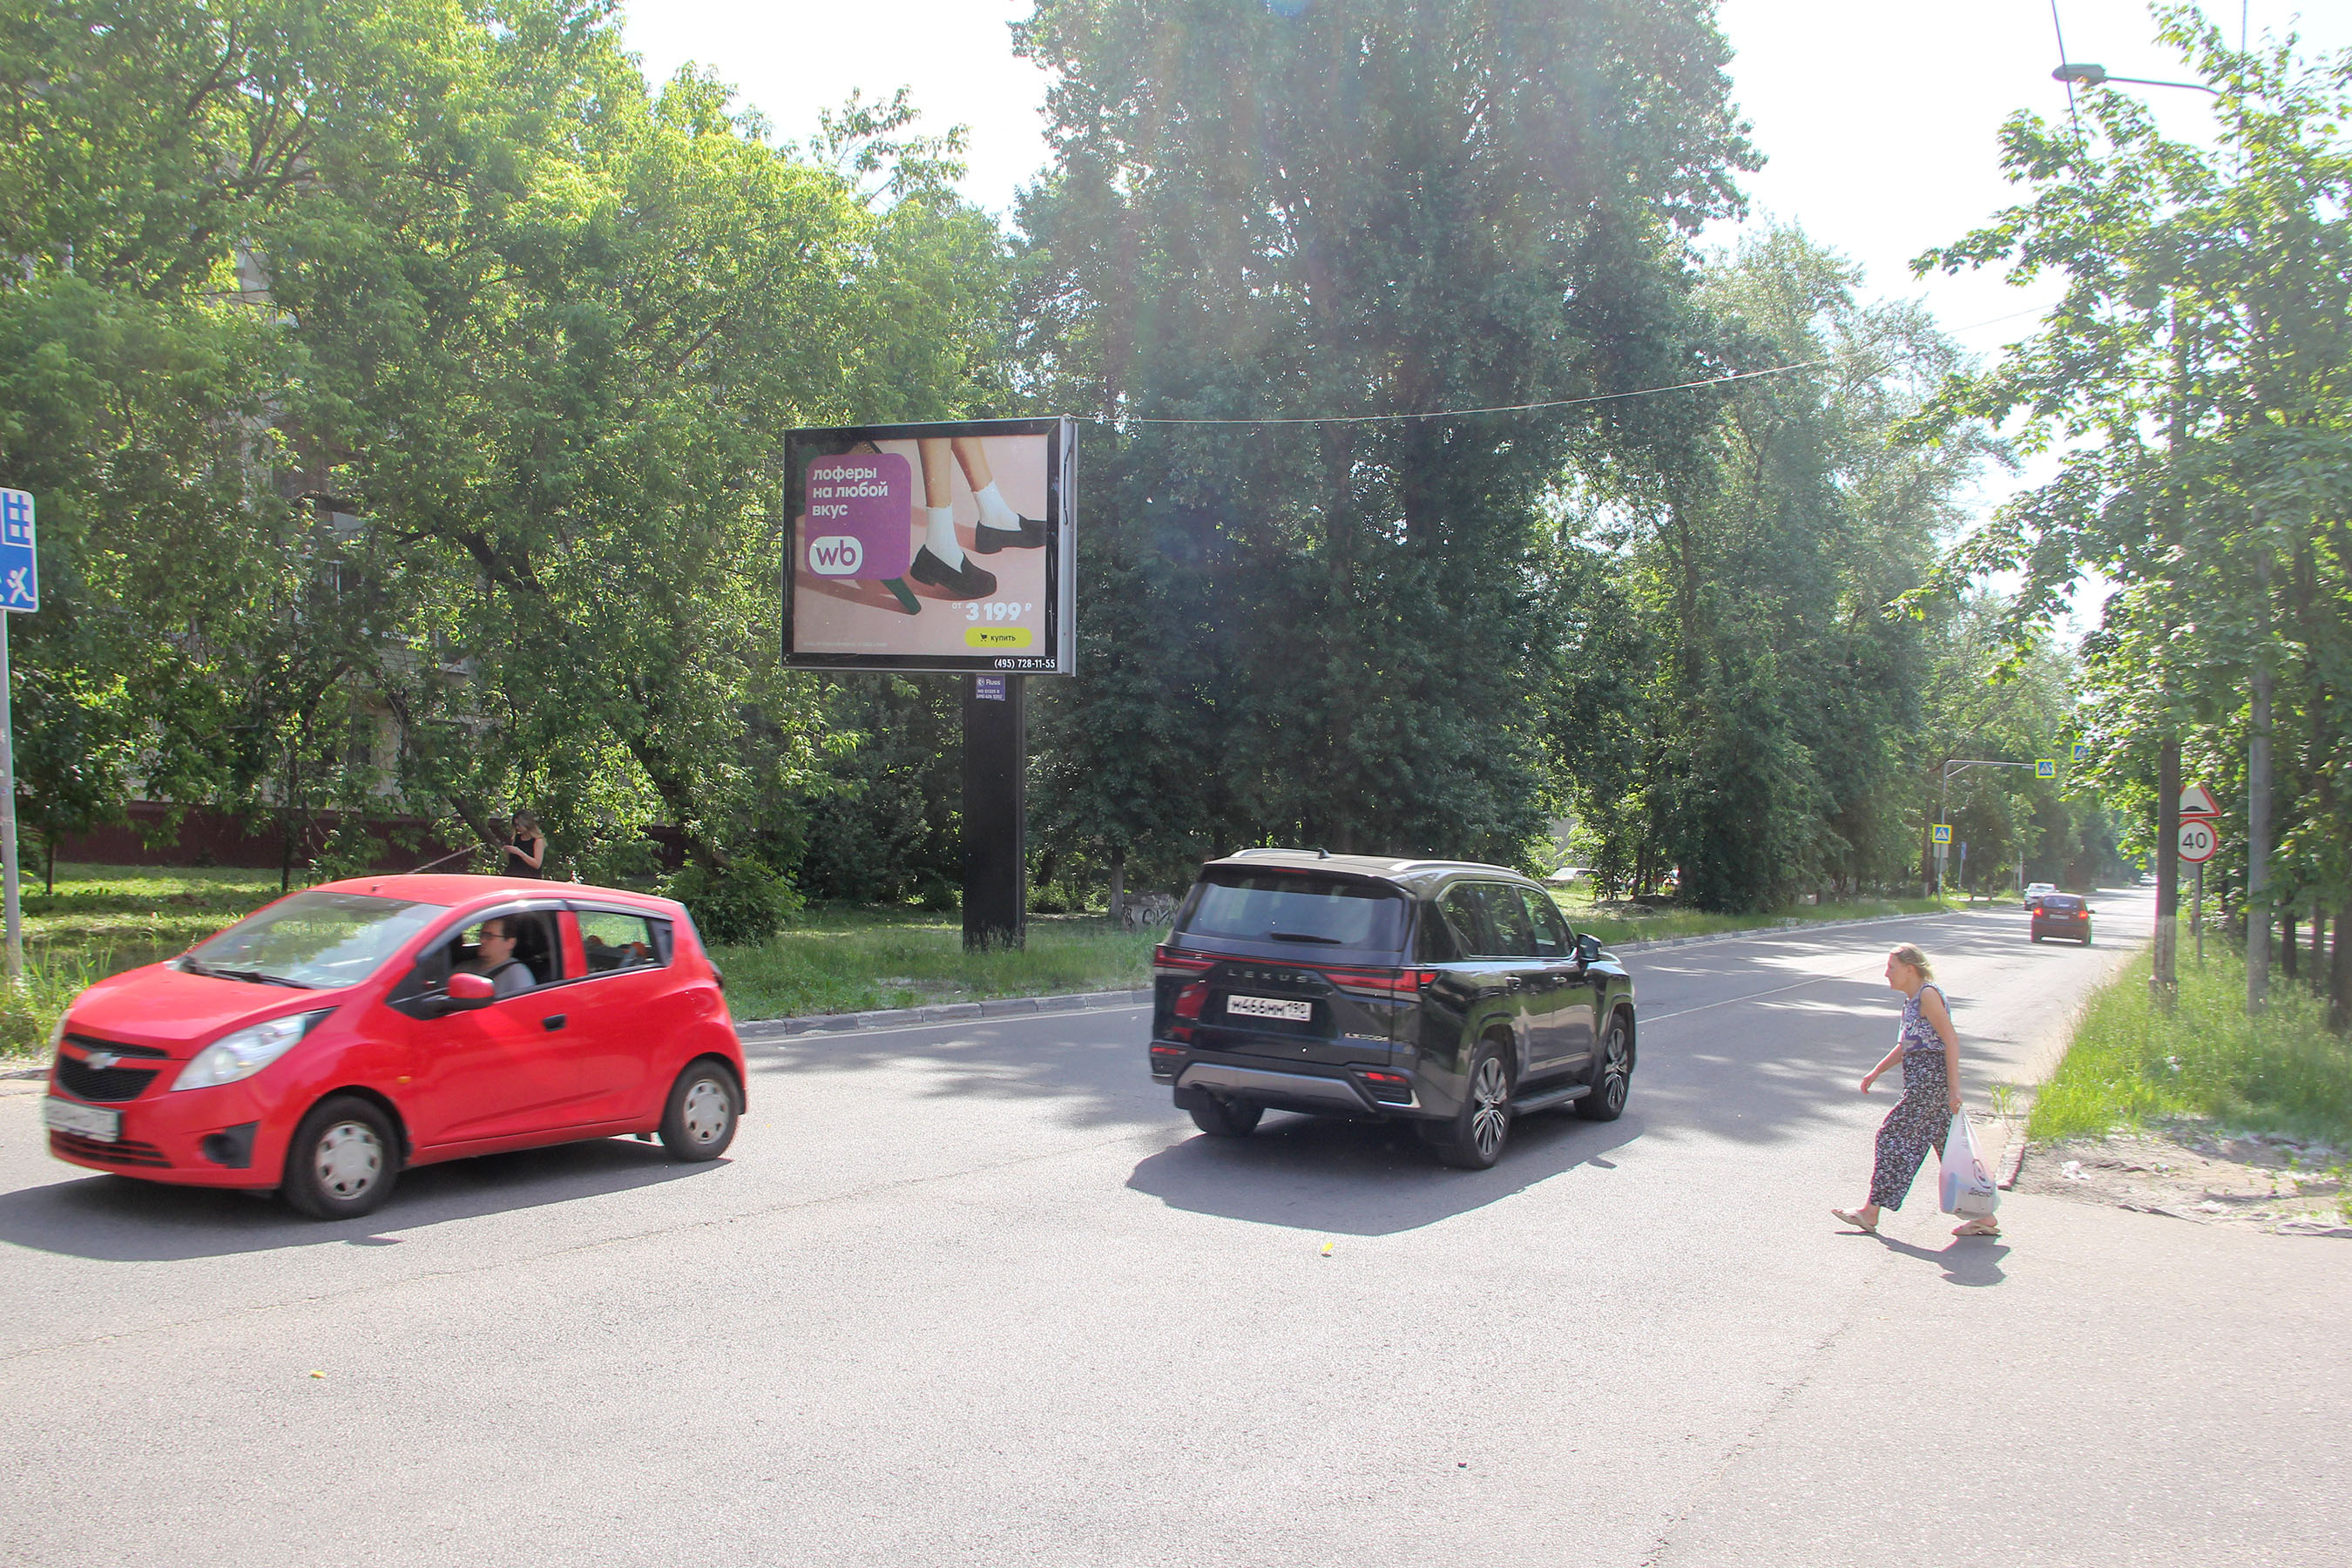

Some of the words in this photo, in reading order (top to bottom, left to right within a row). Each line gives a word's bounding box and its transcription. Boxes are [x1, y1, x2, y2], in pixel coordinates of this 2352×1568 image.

[813, 465, 877, 483] лоферы
[813, 487, 833, 498] на
[835, 481, 889, 497] любой
[812, 504, 848, 519] вкус
[815, 539, 856, 566] wb
[990, 634, 1017, 643] купить
[994, 659, 1016, 669] (495)
[1017, 659, 1056, 668] 728-11-55
[2181, 832, 2207, 849] 40
[1227, 969, 1308, 983] LEXUS
